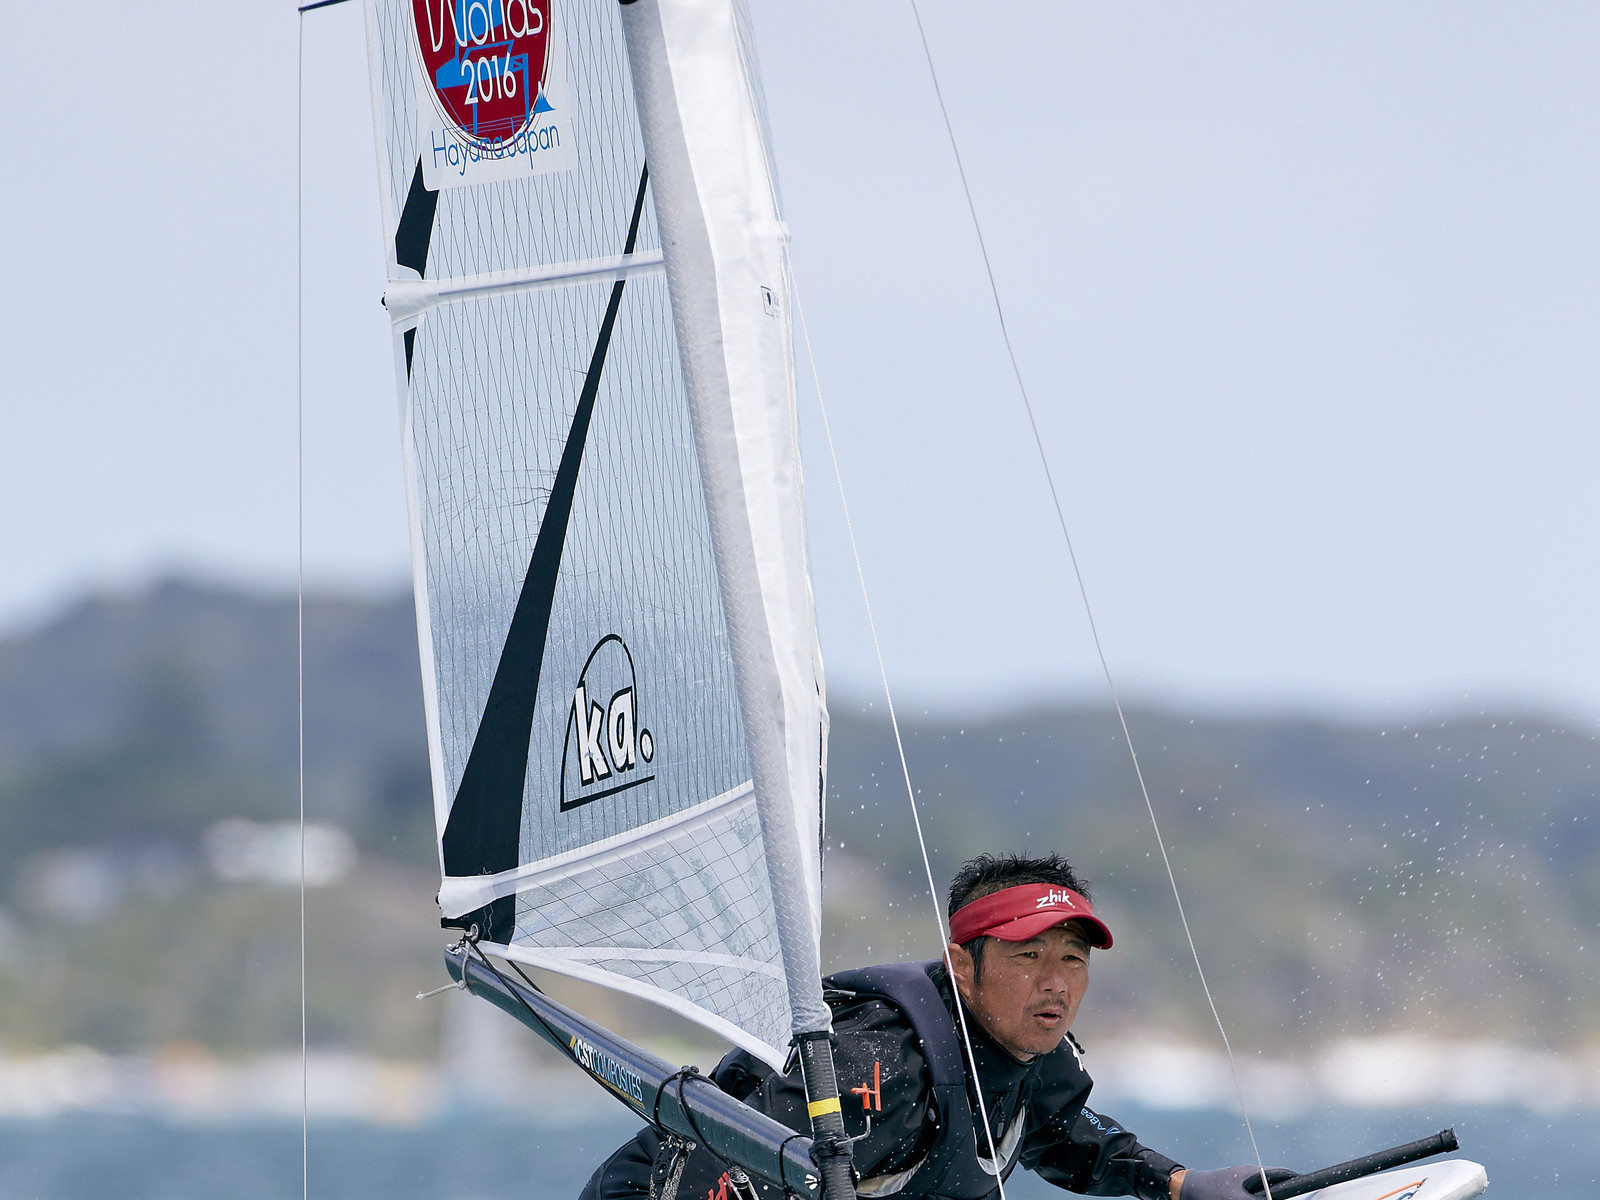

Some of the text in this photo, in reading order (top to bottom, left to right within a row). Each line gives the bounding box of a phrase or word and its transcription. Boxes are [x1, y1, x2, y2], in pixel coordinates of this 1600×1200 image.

[460, 51, 517, 106] 2016
[431, 124, 561, 176] Hayama Japan
